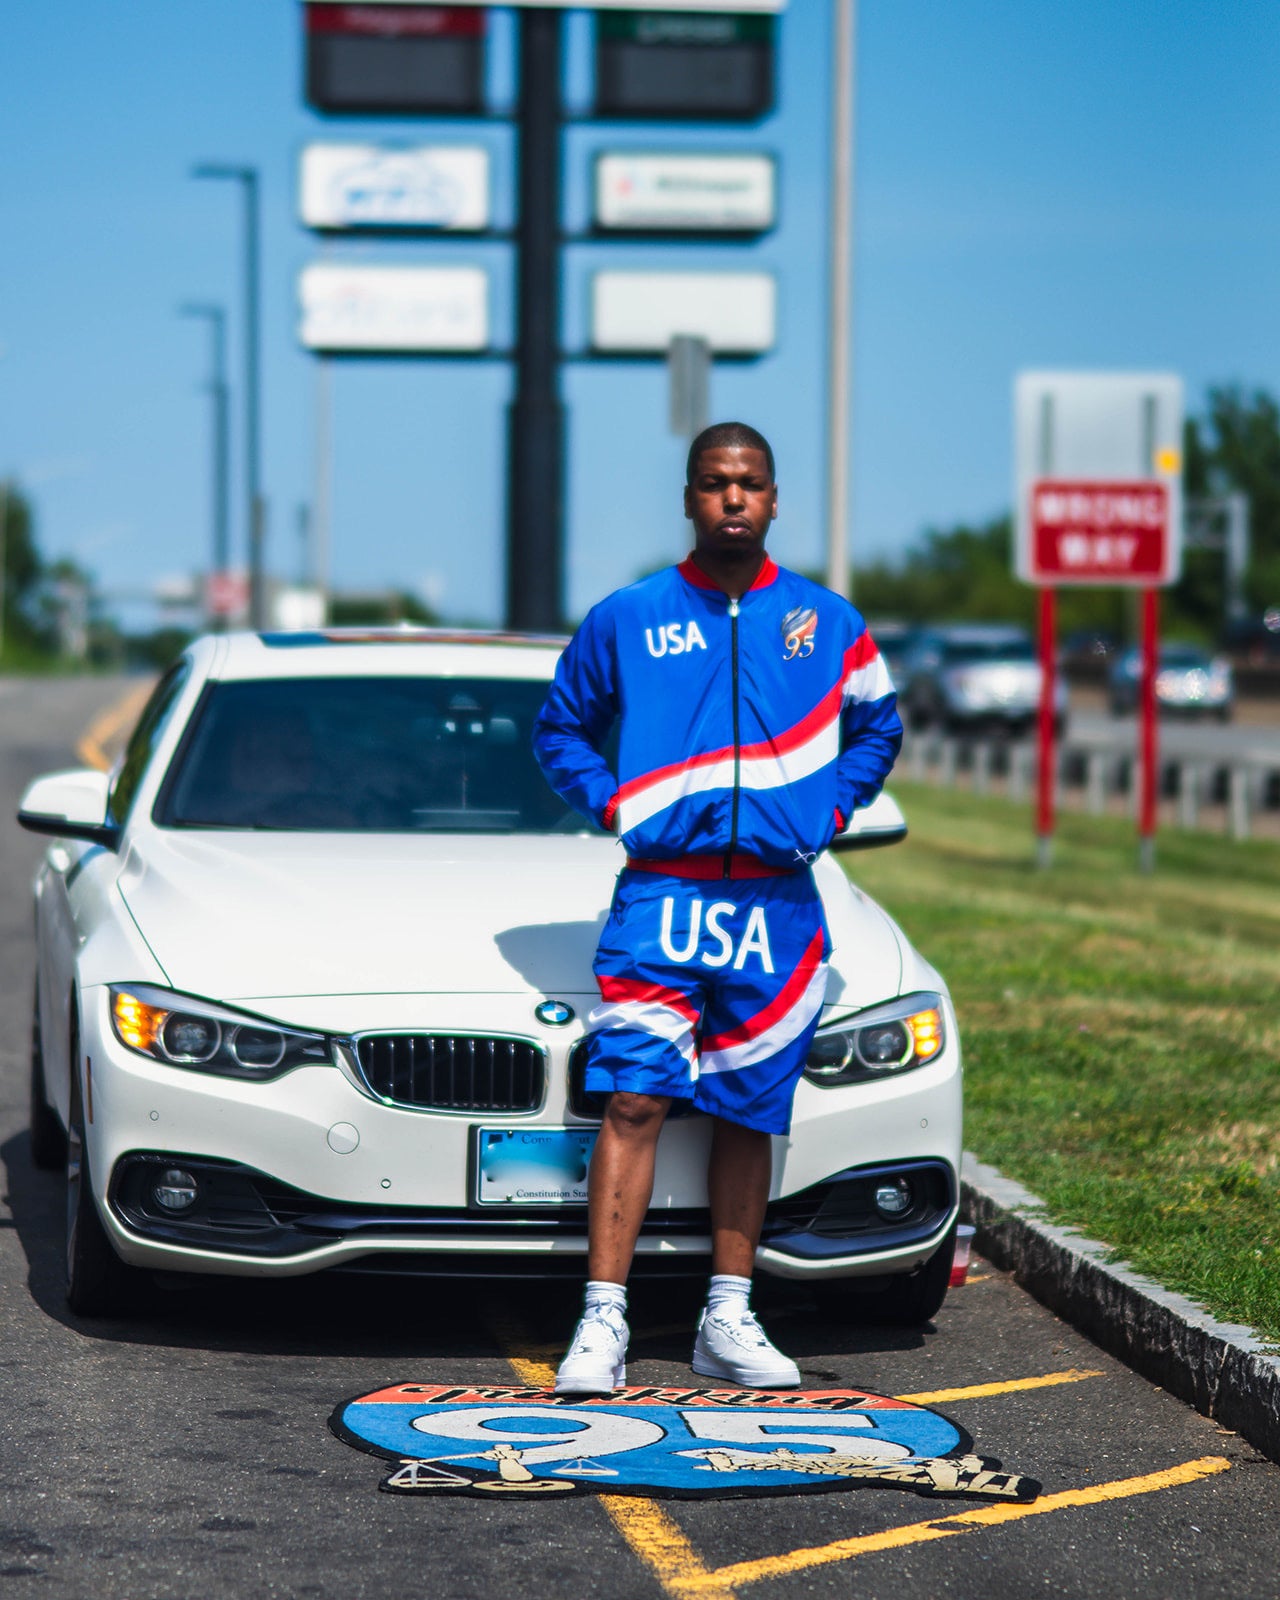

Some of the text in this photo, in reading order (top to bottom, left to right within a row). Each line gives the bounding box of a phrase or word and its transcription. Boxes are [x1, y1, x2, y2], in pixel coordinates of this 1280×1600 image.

[1037, 492, 1167, 527] WRONG
[1058, 534, 1140, 567] WAY
[645, 620, 707, 658] USA
[782, 634, 815, 661] 95
[660, 897, 775, 974] USA
[516, 1188, 589, 1198] Constitution Sta
[409, 1406, 914, 1466] 95
